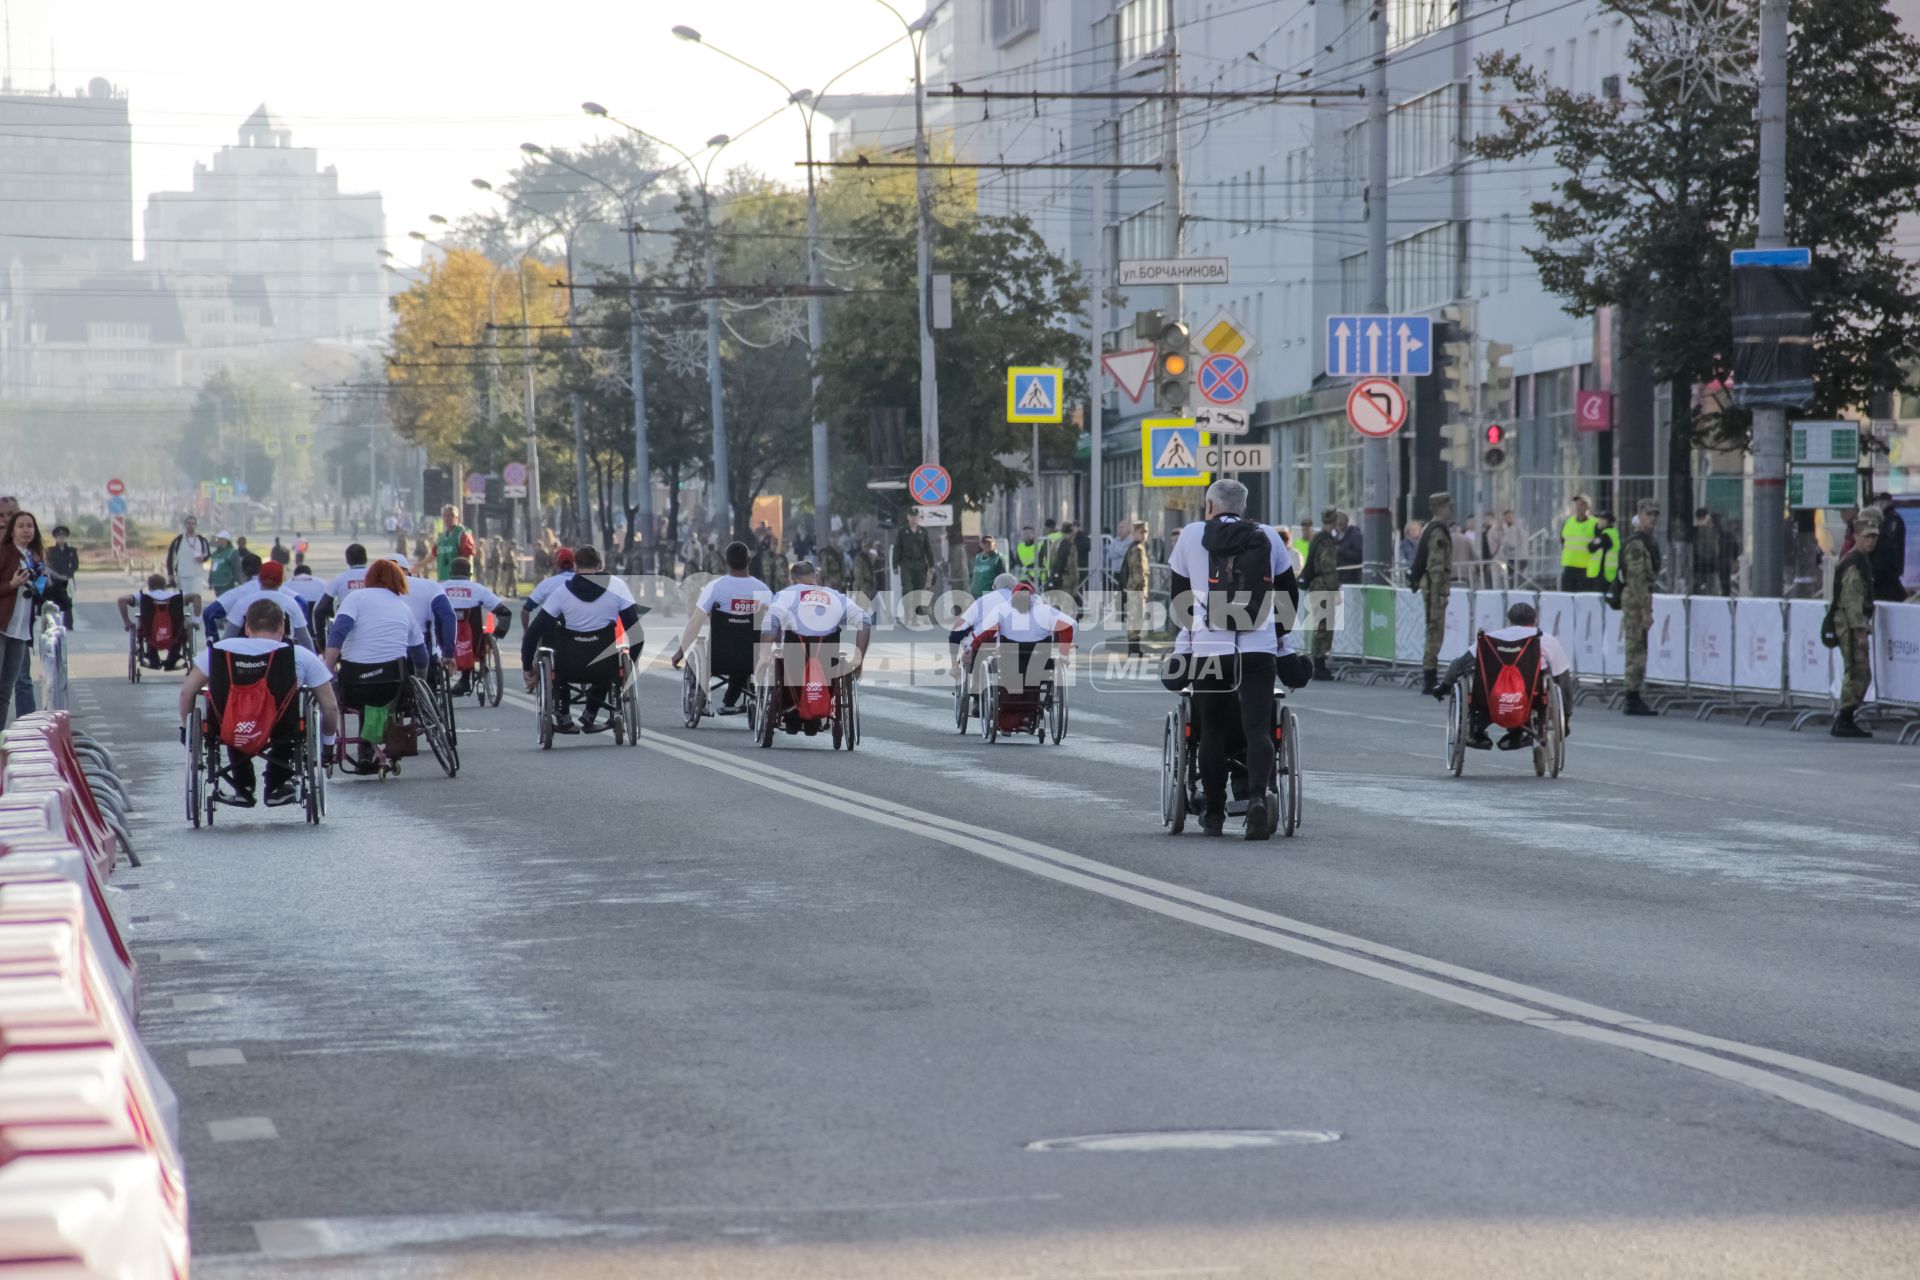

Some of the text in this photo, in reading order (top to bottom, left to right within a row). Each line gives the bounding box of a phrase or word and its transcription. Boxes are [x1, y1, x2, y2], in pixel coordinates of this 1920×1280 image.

[1123, 265, 1224, 282] ул.БОРЧАНИНОВА
[1206, 449, 1261, 467] СТОП
[802, 592, 828, 604] 9993
